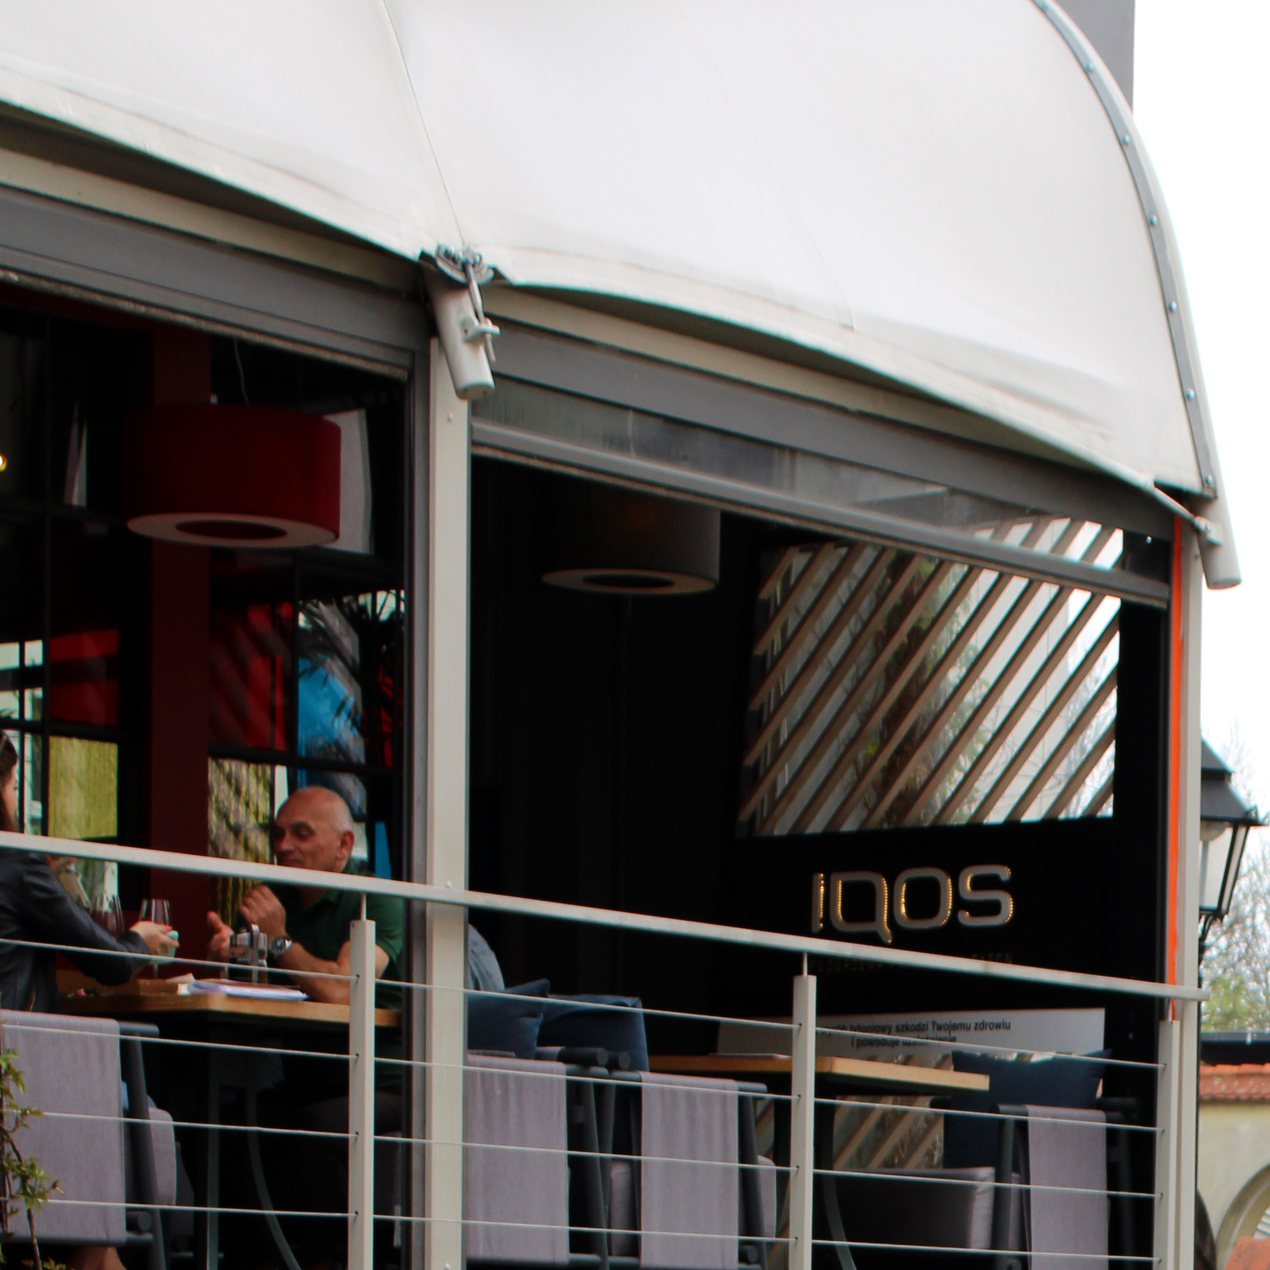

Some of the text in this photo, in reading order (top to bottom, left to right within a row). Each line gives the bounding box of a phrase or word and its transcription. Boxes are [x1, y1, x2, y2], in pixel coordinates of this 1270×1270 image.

[811, 864, 1014, 944] IQOS
[895, 1020, 928, 1033] szkodzi
[931, 1019, 971, 1036] Twojemu
[974, 1018, 1011, 1031] zdrowiu
